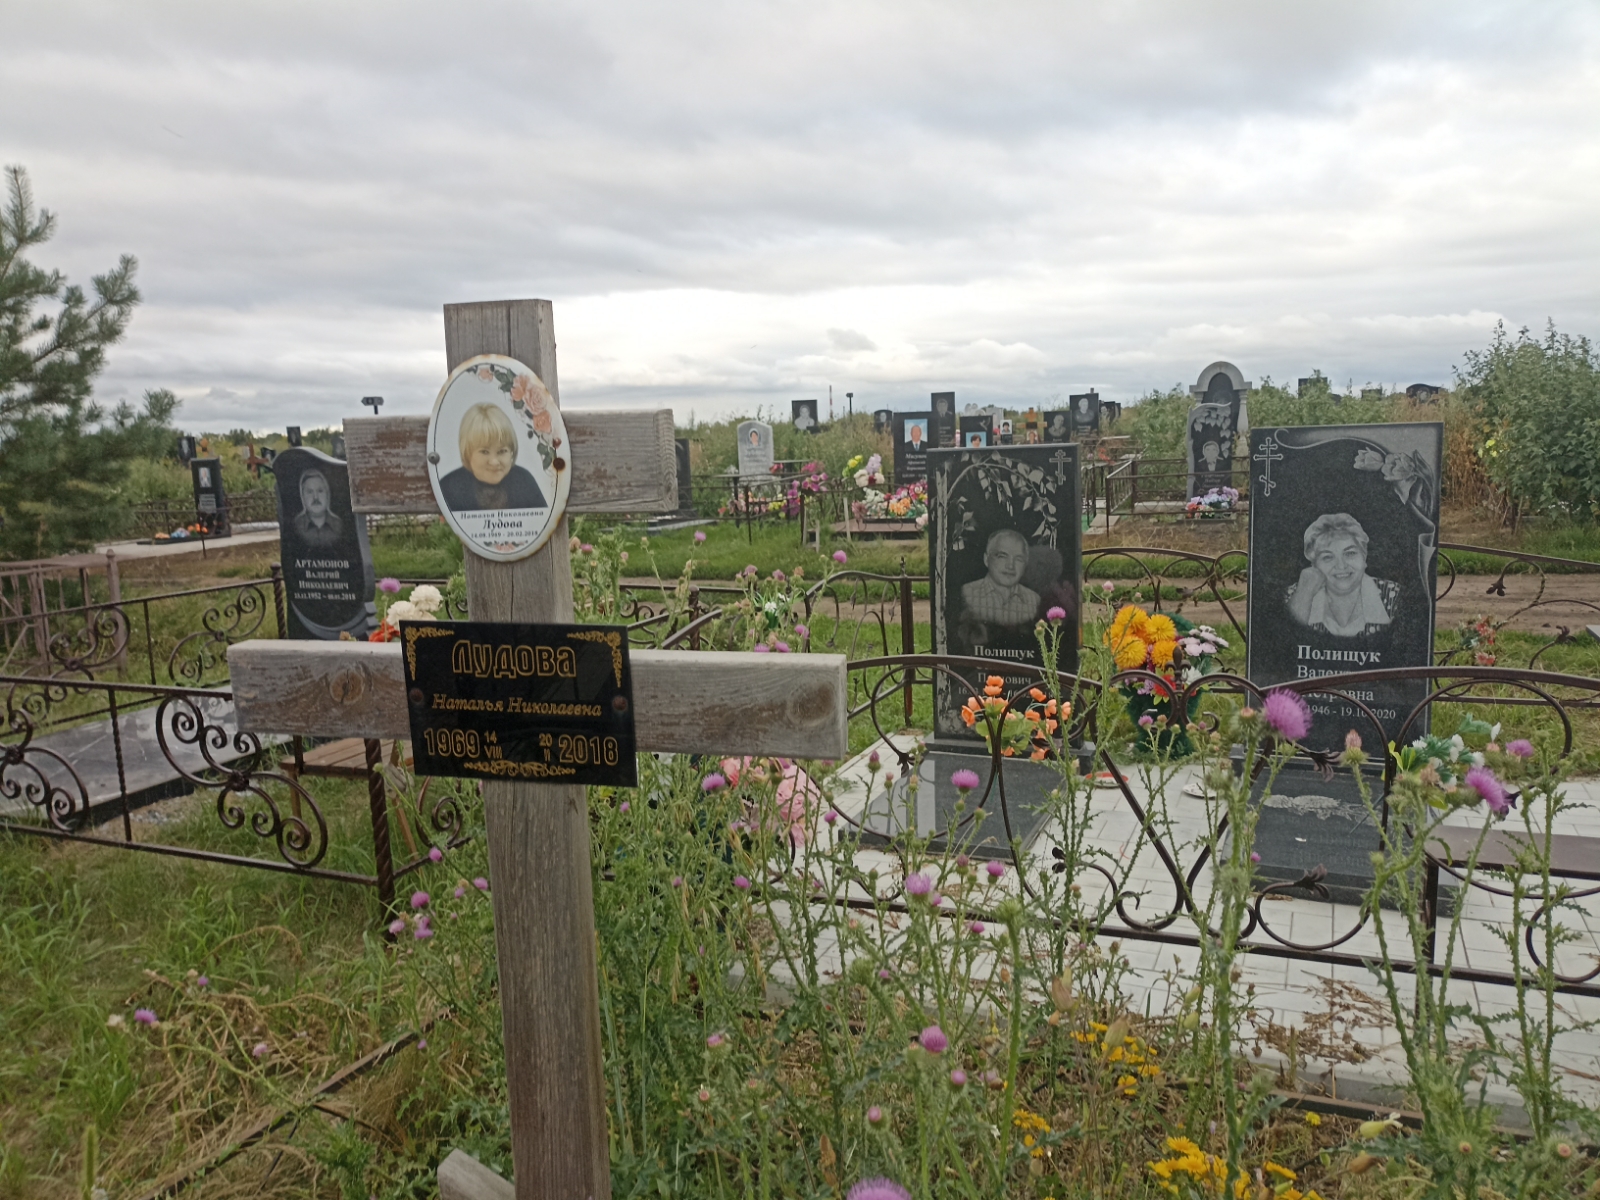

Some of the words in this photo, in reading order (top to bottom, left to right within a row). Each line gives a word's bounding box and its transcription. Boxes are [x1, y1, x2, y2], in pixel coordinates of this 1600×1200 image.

[483, 519, 523, 532] Лудова
[452, 639, 577, 679] Лудова
[974, 645, 1035, 660] Полищук
[1297, 645, 1381, 666] Полищук
[978, 672, 1032, 685] Пович
[431, 693, 504, 712] Наталья
[507, 697, 602, 717] Николаевна
[423, 727, 480, 758] 1969
[484, 730, 497, 744] 14
[538, 733, 553, 747] 20
[484, 745, 503, 760] VIII
[558, 734, 619, 766] 2018
